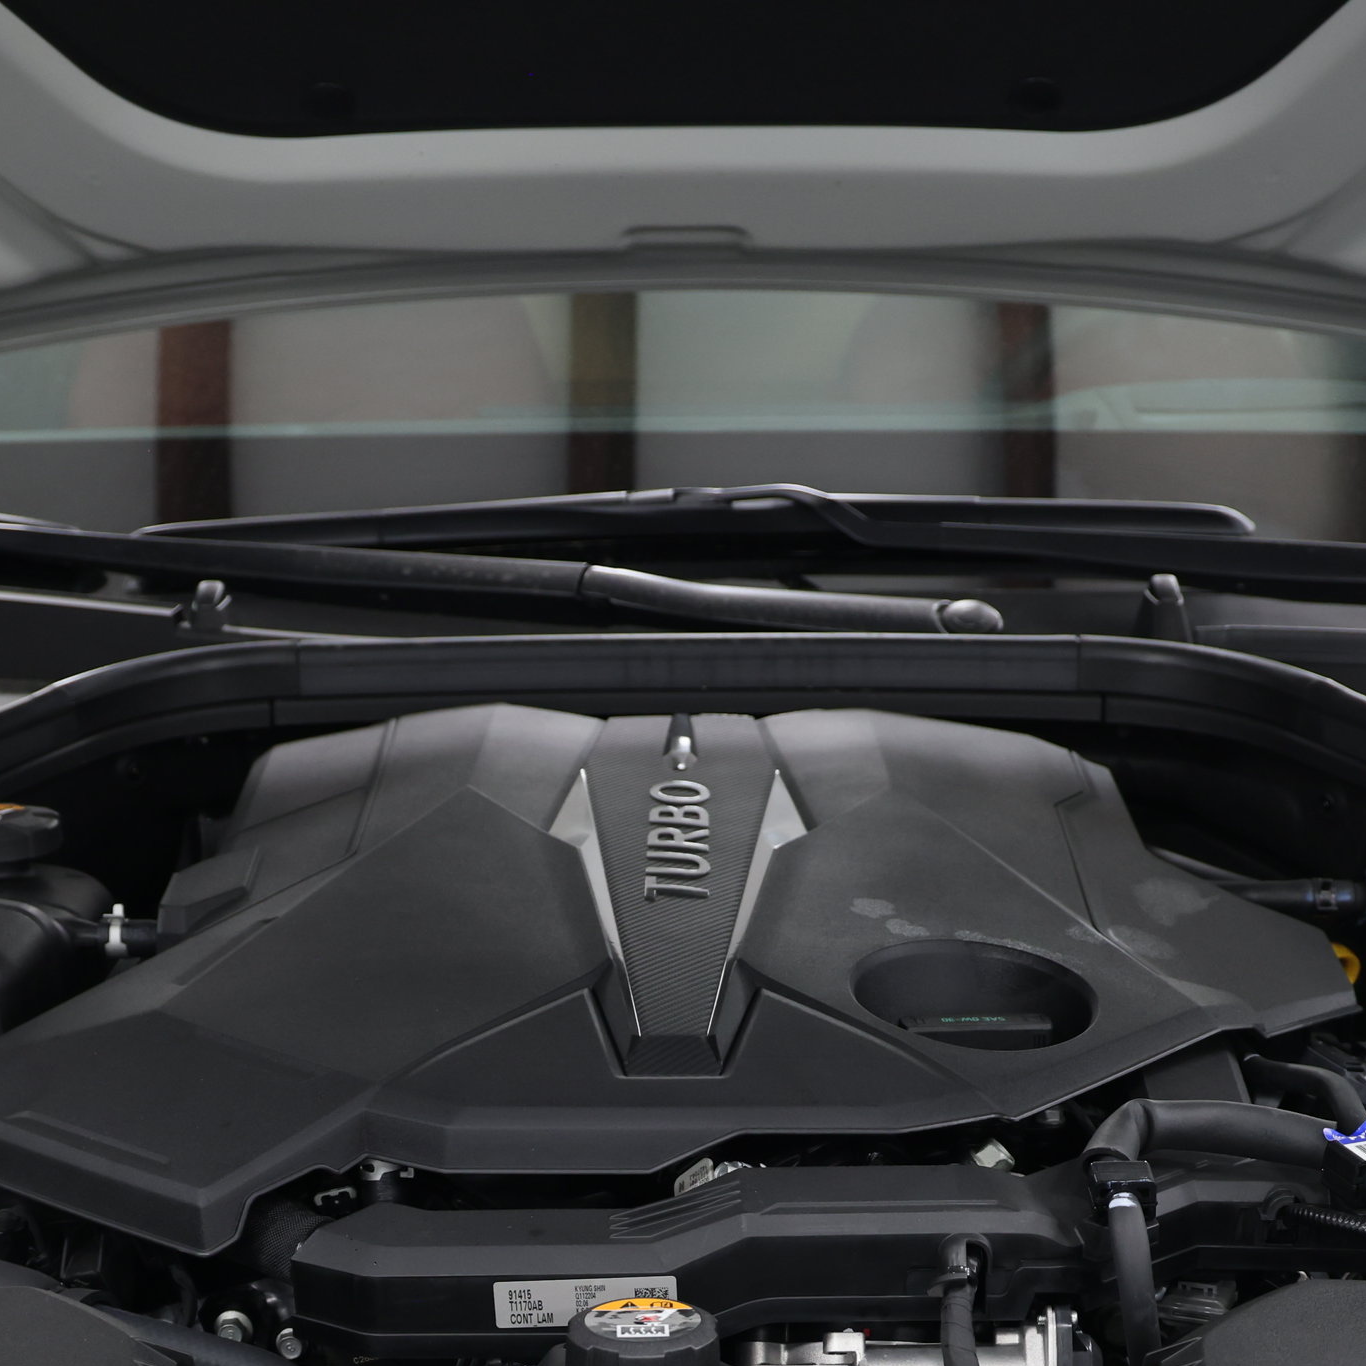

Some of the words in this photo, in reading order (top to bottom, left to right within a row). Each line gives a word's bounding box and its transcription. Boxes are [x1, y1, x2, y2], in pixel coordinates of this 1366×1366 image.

[644, 780, 711, 901] TURBO
[508, 1289, 532, 1300] 91415
[509, 1300, 544, 1311] T1170AB
